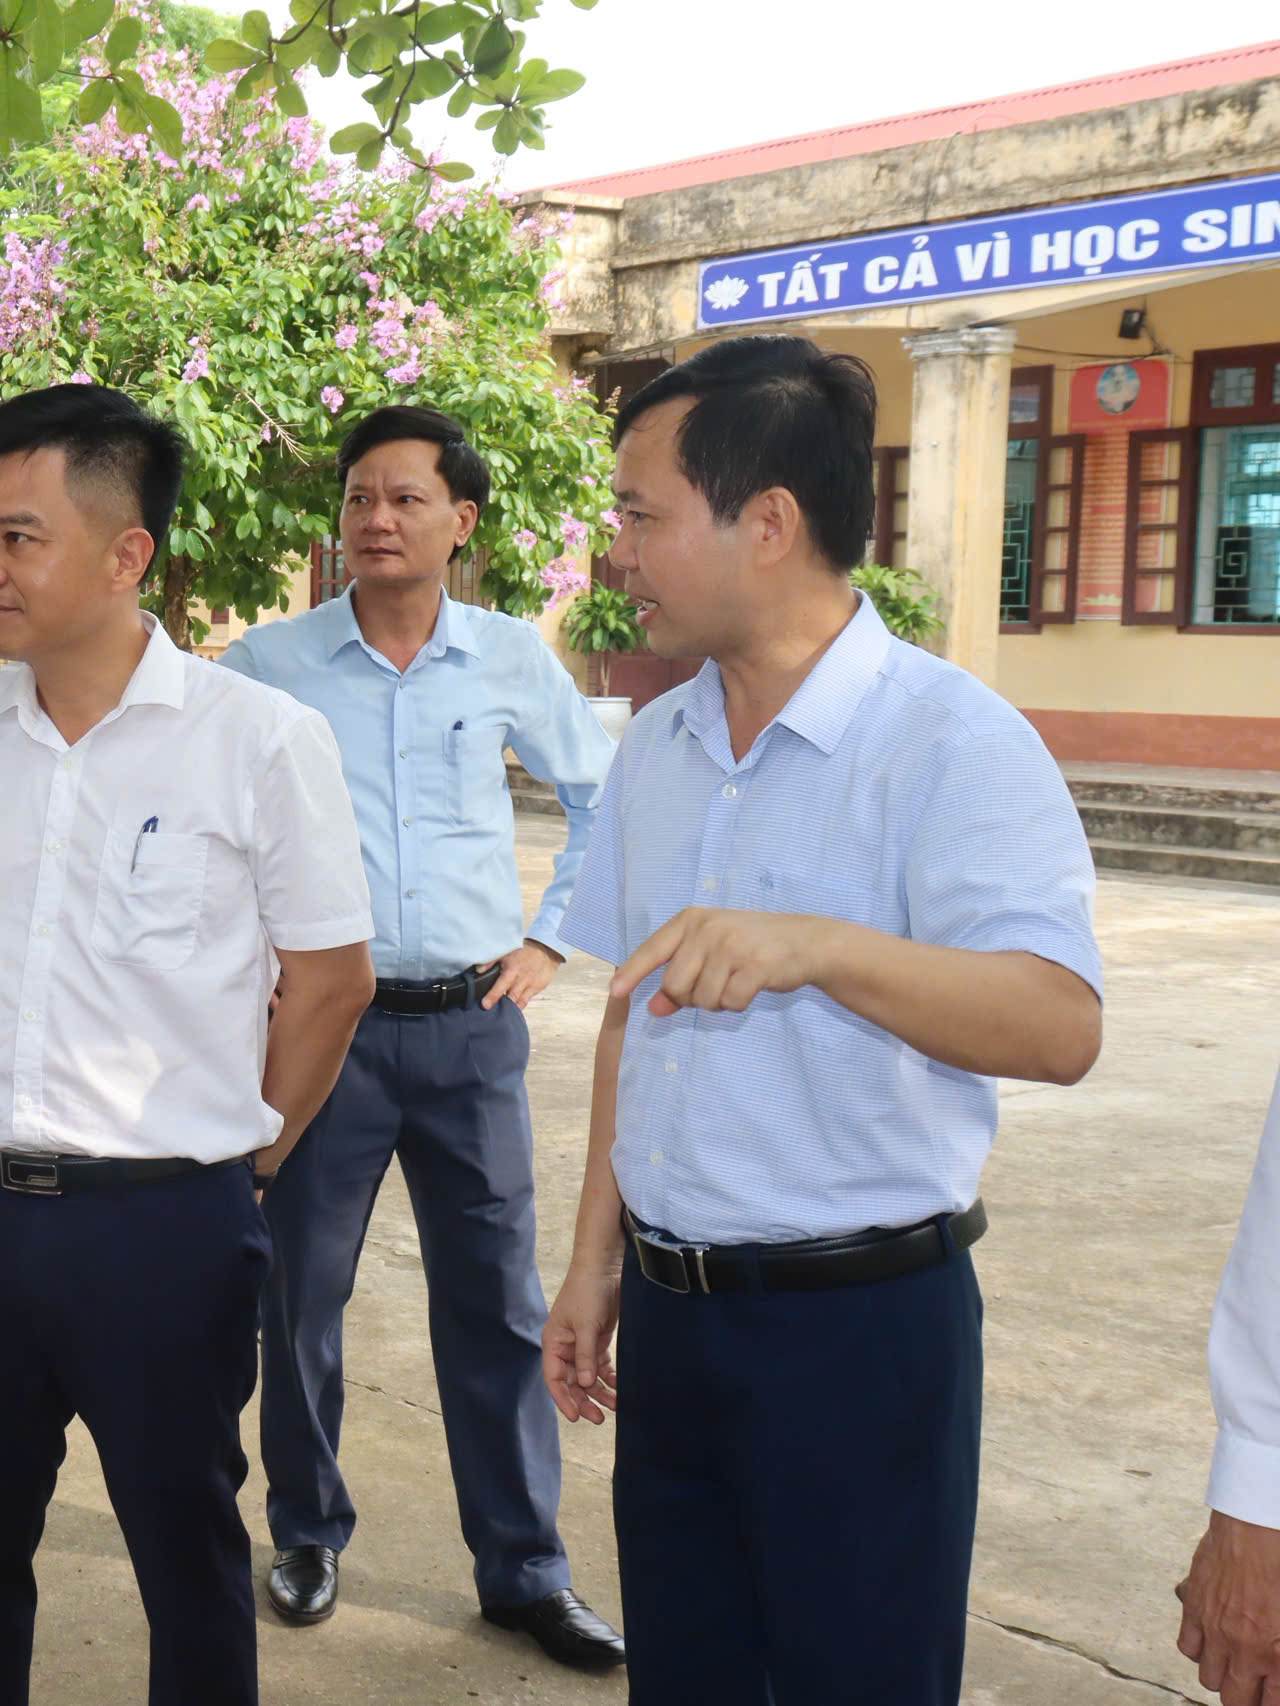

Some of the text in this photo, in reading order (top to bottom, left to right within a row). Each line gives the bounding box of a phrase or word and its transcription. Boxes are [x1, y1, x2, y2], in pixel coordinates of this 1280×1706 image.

[756, 252, 849, 308] TẤT
[864, 234, 939, 295] CẢ
[956, 230, 1011, 283] VÌ
[1030, 218, 1161, 275] HỌC
